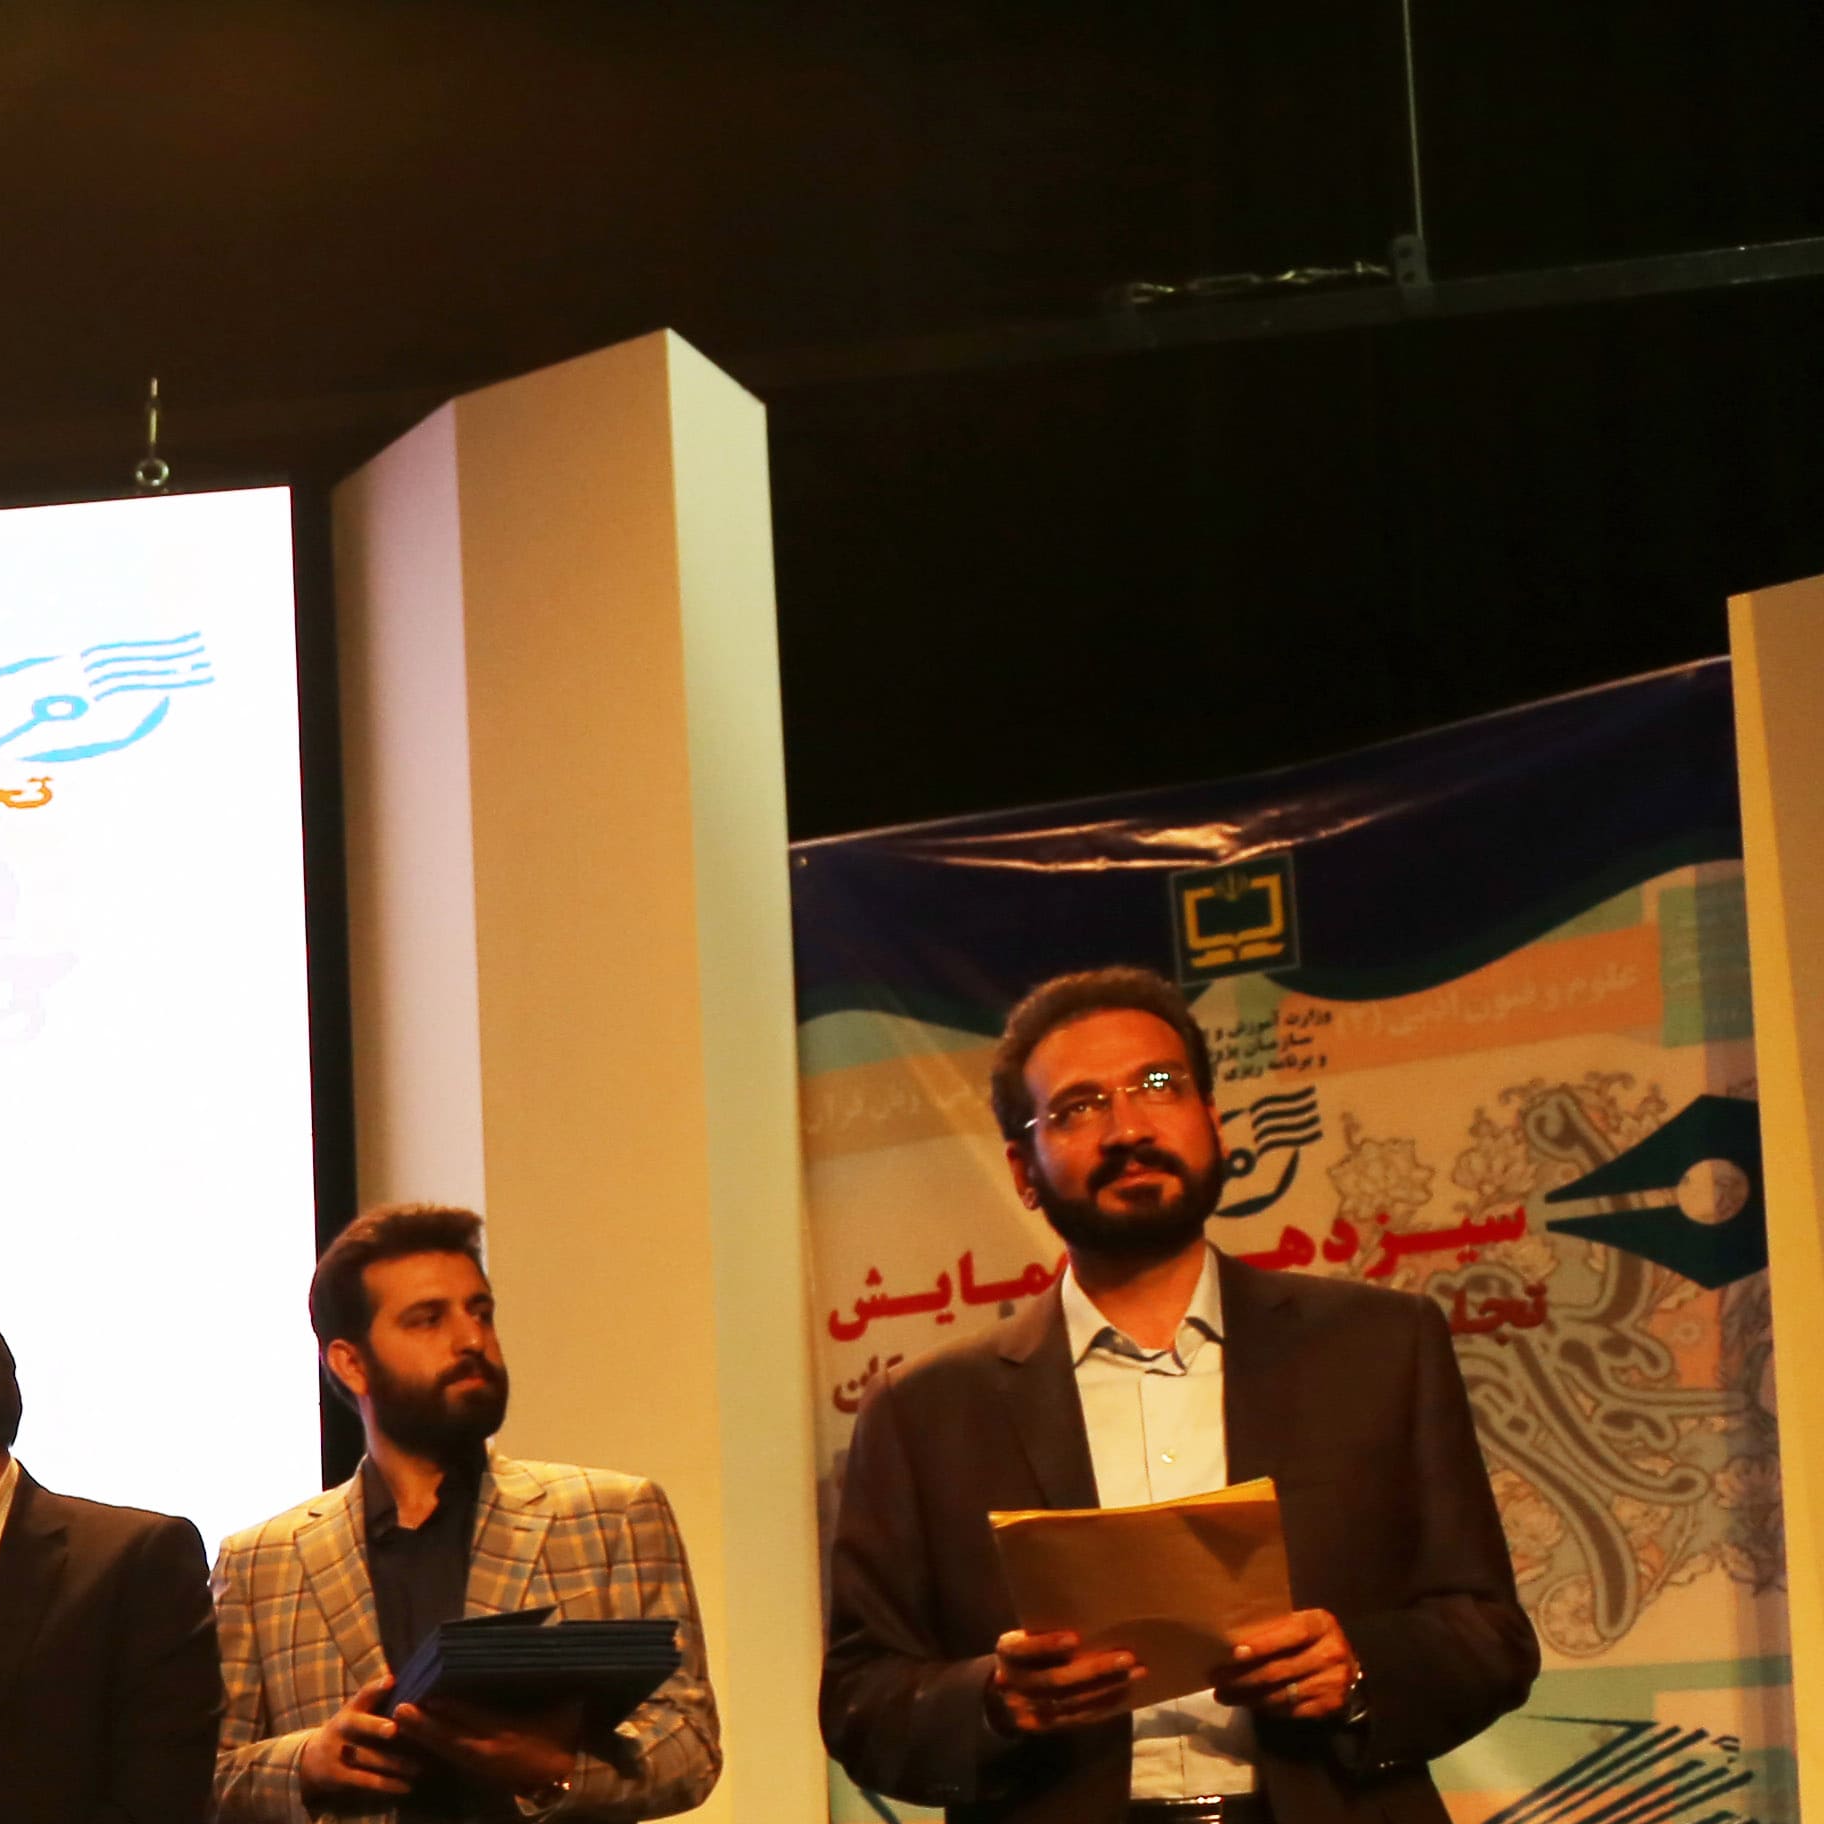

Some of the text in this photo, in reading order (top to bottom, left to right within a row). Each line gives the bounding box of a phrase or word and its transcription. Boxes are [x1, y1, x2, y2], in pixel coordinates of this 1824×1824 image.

[828, 1205, 1527, 1341] سیزده مایش
[1451, 1281, 1549, 1347] تجل
